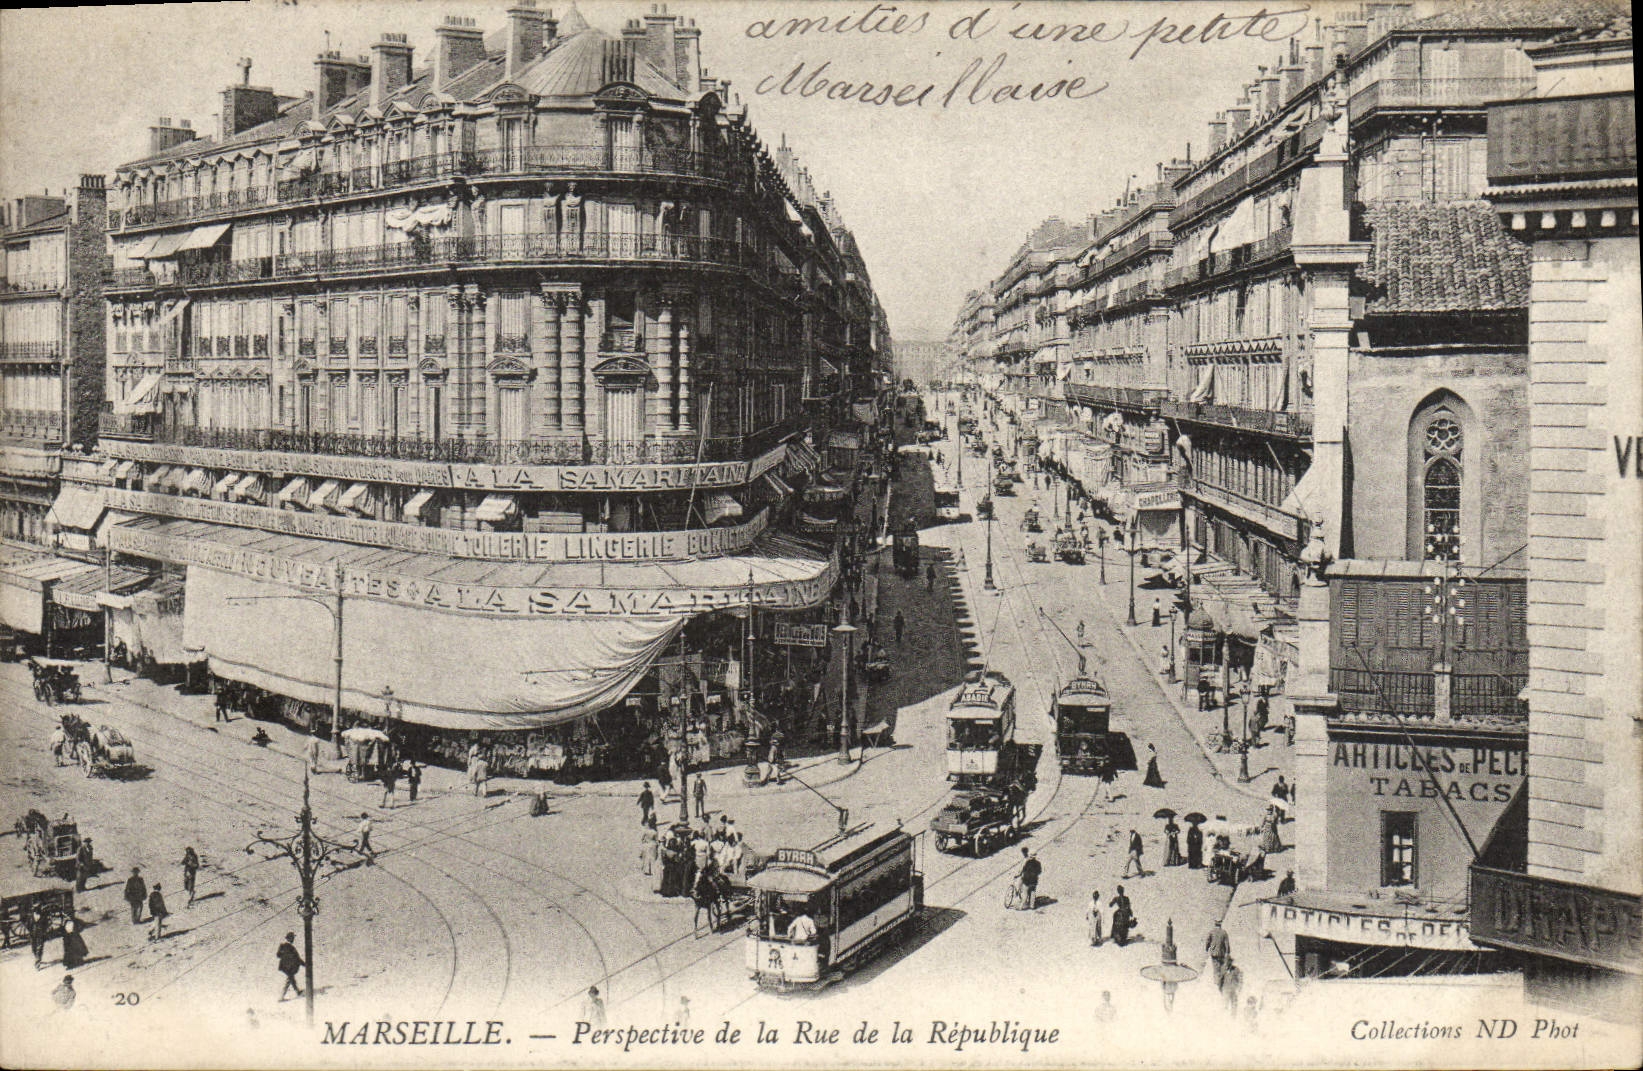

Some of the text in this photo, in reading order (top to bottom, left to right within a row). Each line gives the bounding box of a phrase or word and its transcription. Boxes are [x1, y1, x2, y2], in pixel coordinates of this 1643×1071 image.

[950, 2, 1129, 42] d'une
[1129, 4, 1312, 60] petite
[755, 51, 1109, 108] Marseillaise
[464, 467, 484, 488] A
[492, 468, 544, 490] LA
[565, 535, 674, 559] LINGERIE
[423, 583, 450, 608] A
[456, 585, 520, 613] LA
[1333, 742, 1456, 774] ARTICLES
[1369, 776, 1513, 803] TABACS
[777, 849, 815, 865] BYRRH
